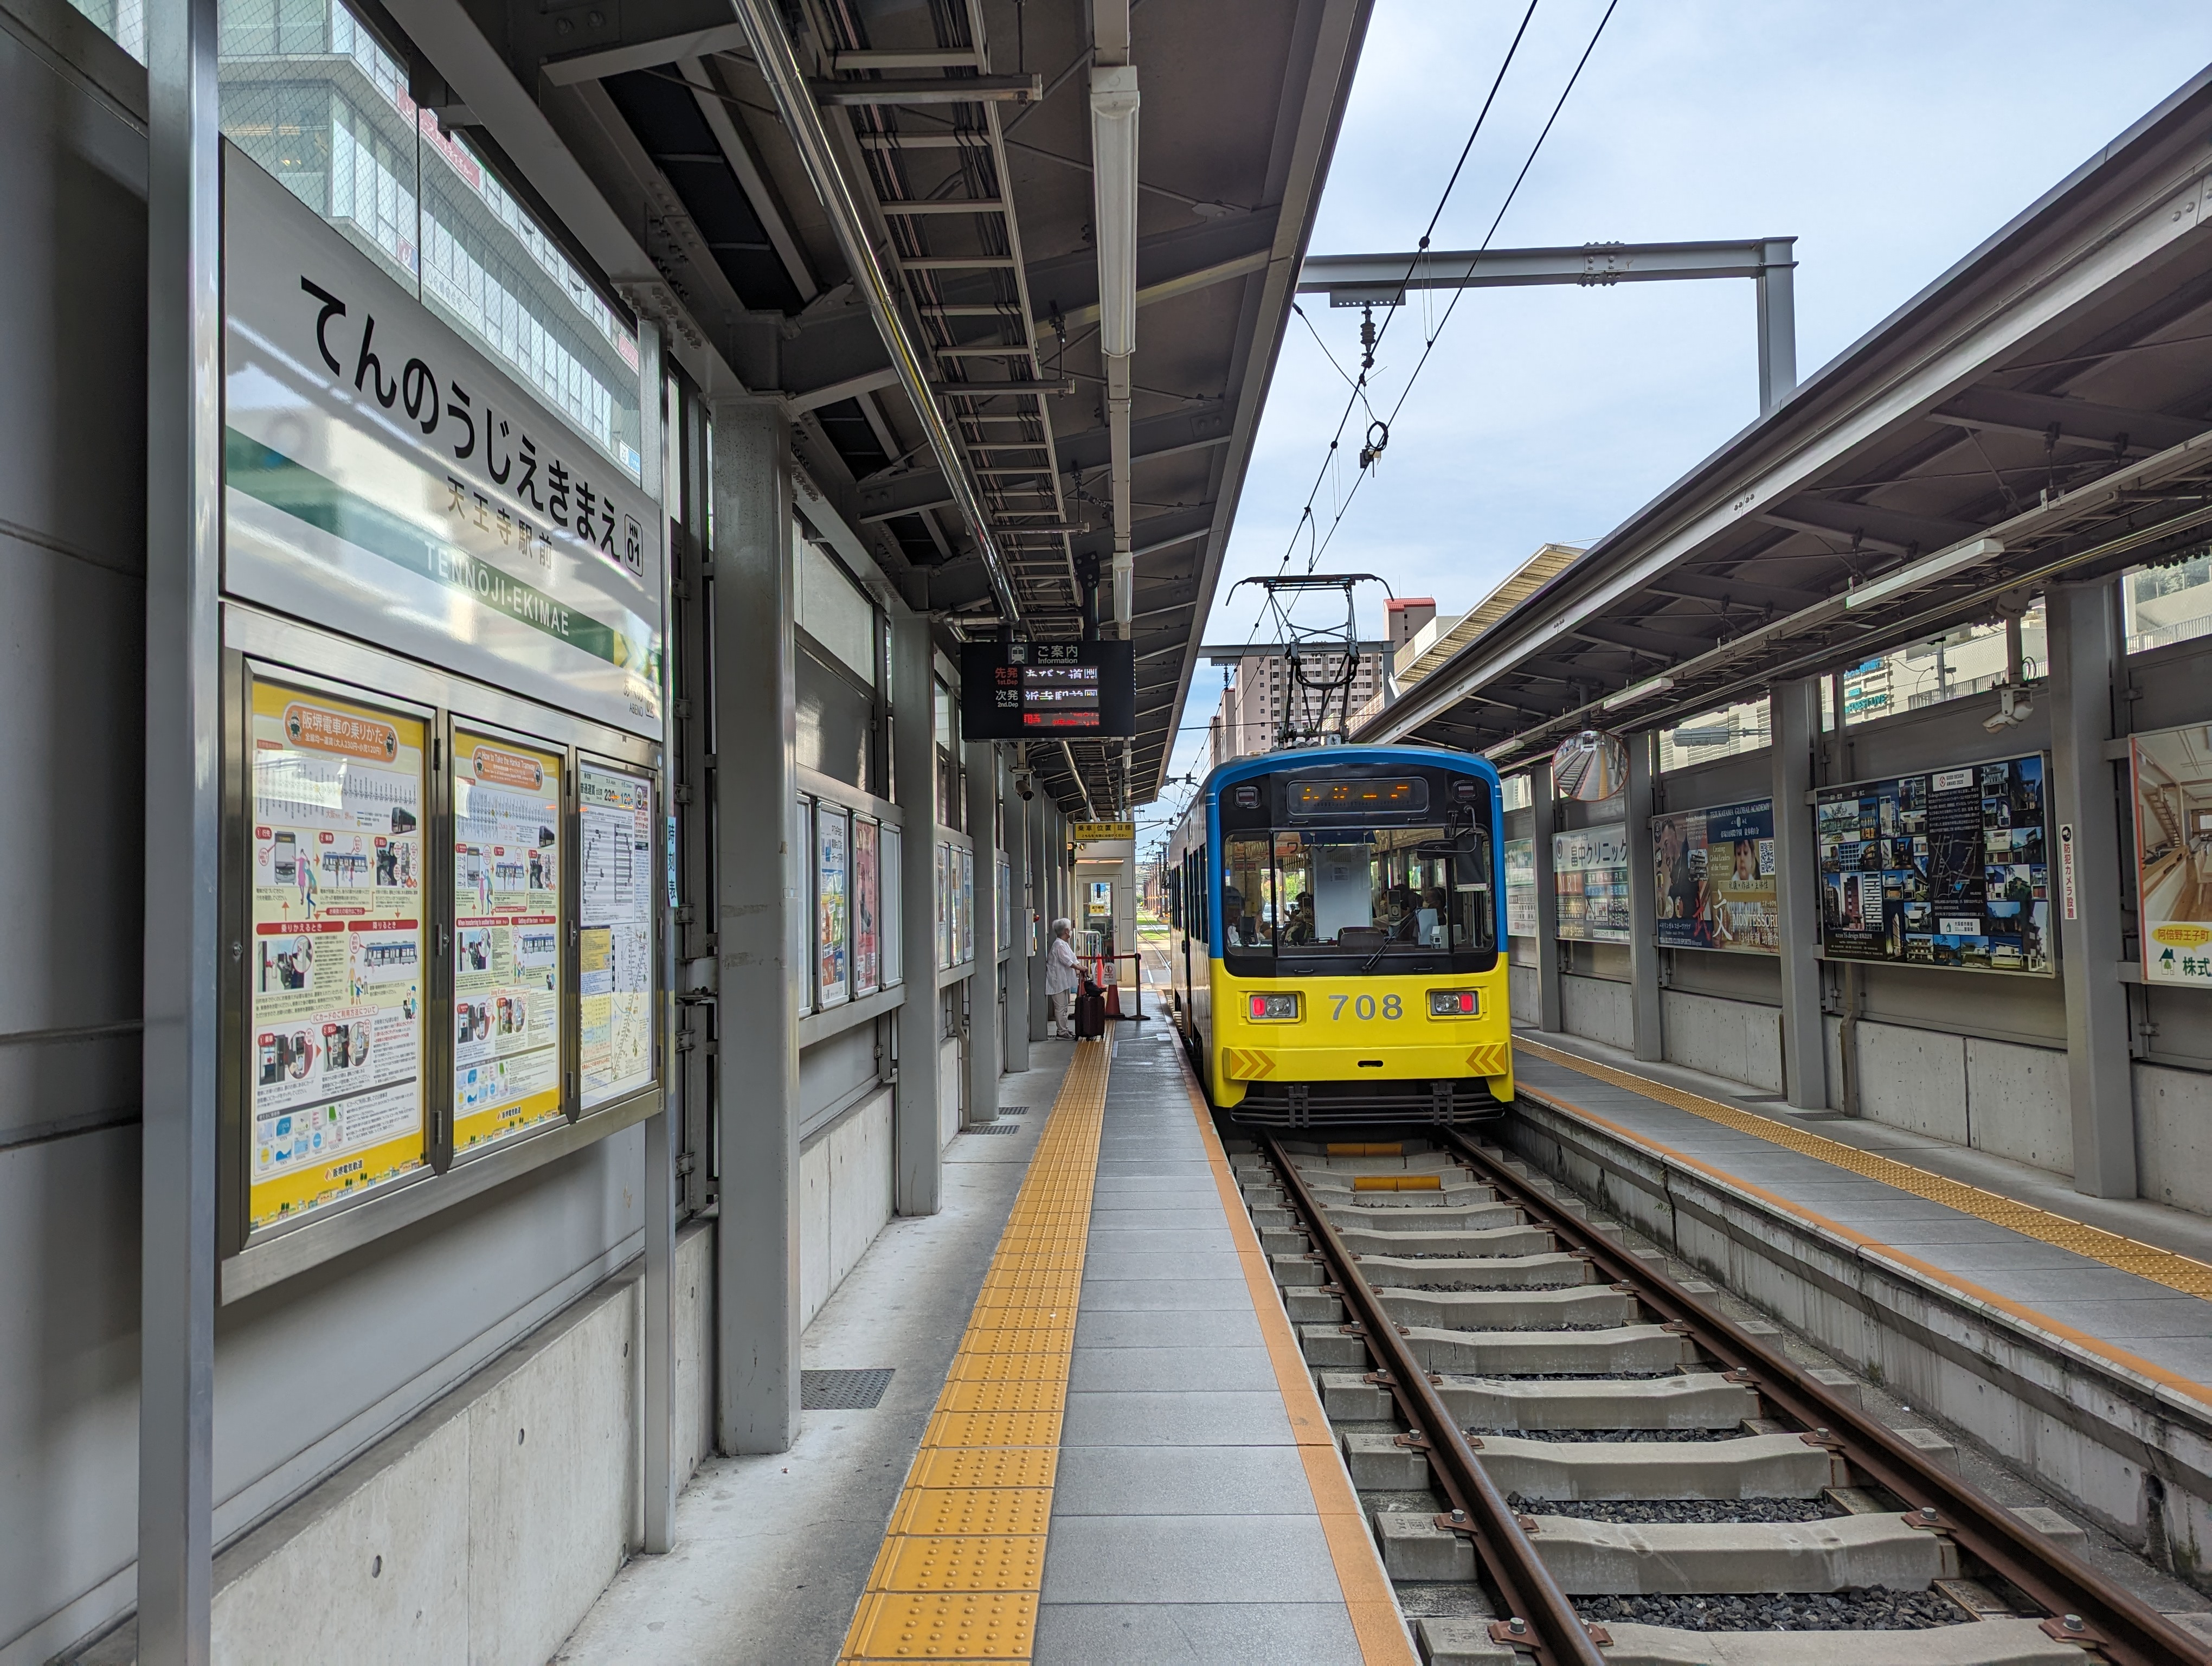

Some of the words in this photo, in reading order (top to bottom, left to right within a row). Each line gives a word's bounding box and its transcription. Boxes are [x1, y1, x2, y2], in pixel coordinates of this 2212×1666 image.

[300, 275, 621, 563] てんのうじえきまえ
[447, 475, 552, 568] 天王寺駅前
[628, 525, 639, 539] HN
[627, 539, 641, 568] 01
[425, 542, 570, 637] TENNŌJI-EKIMAE
[1038, 645, 1078, 658] ご案内
[995, 667, 1018, 678] 先発
[995, 689, 1019, 701] 次発
[1871, 694, 1886, 706] LIVE
[302, 711, 383, 744] 阪堺電車の乗りかた
[1710, 809, 1734, 818] TEZUKAYAMA
[1735, 806, 1751, 815] GLOBAL
[1751, 803, 1770, 812] ACADEMY
[1571, 838, 1626, 867] 畠中クリニック
[1713, 845, 1726, 854] Creating
[668, 824, 677, 900] 時刻表
[1559, 875, 1577, 892] MRI
[2063, 843, 2074, 919] 防犯カメラ設置
[1712, 889, 1733, 941] 文
[1733, 913, 1778, 927] MONTESSORI
[281, 923, 323, 933] 乗りかえるとき
[372, 921, 396, 930] 降りるとき
[2158, 929, 2209, 943] 阿倍野王子町
[2183, 956, 2212, 977] 株式
[313, 1006, 376, 1022] ICカードのご利用方法について
[1328, 994, 1404, 1021] 708
[333, 1159, 364, 1178] 阪堺電気軌道
